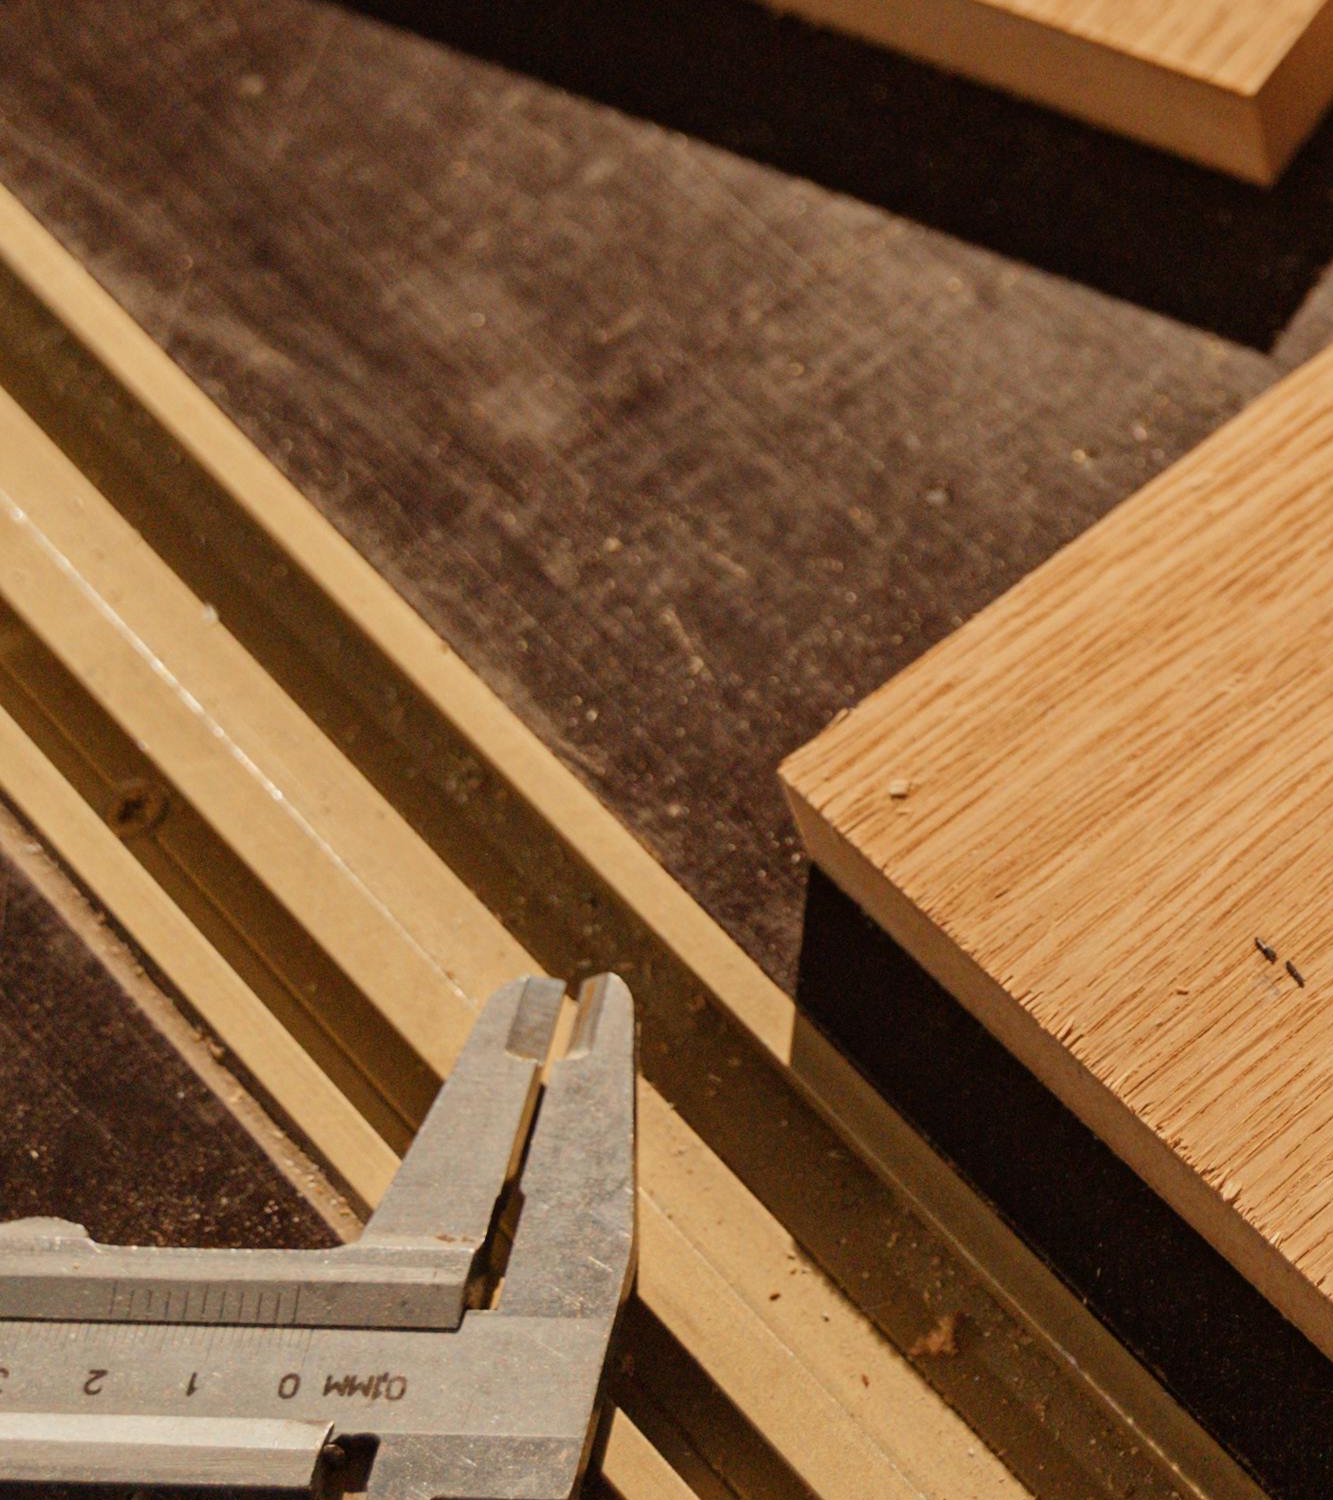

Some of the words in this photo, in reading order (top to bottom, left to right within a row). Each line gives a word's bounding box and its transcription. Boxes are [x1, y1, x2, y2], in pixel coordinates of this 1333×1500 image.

[83, 1368, 109, 1396] 2
[186, 1371, 198, 1397] 1
[277, 1372, 300, 1400] 0
